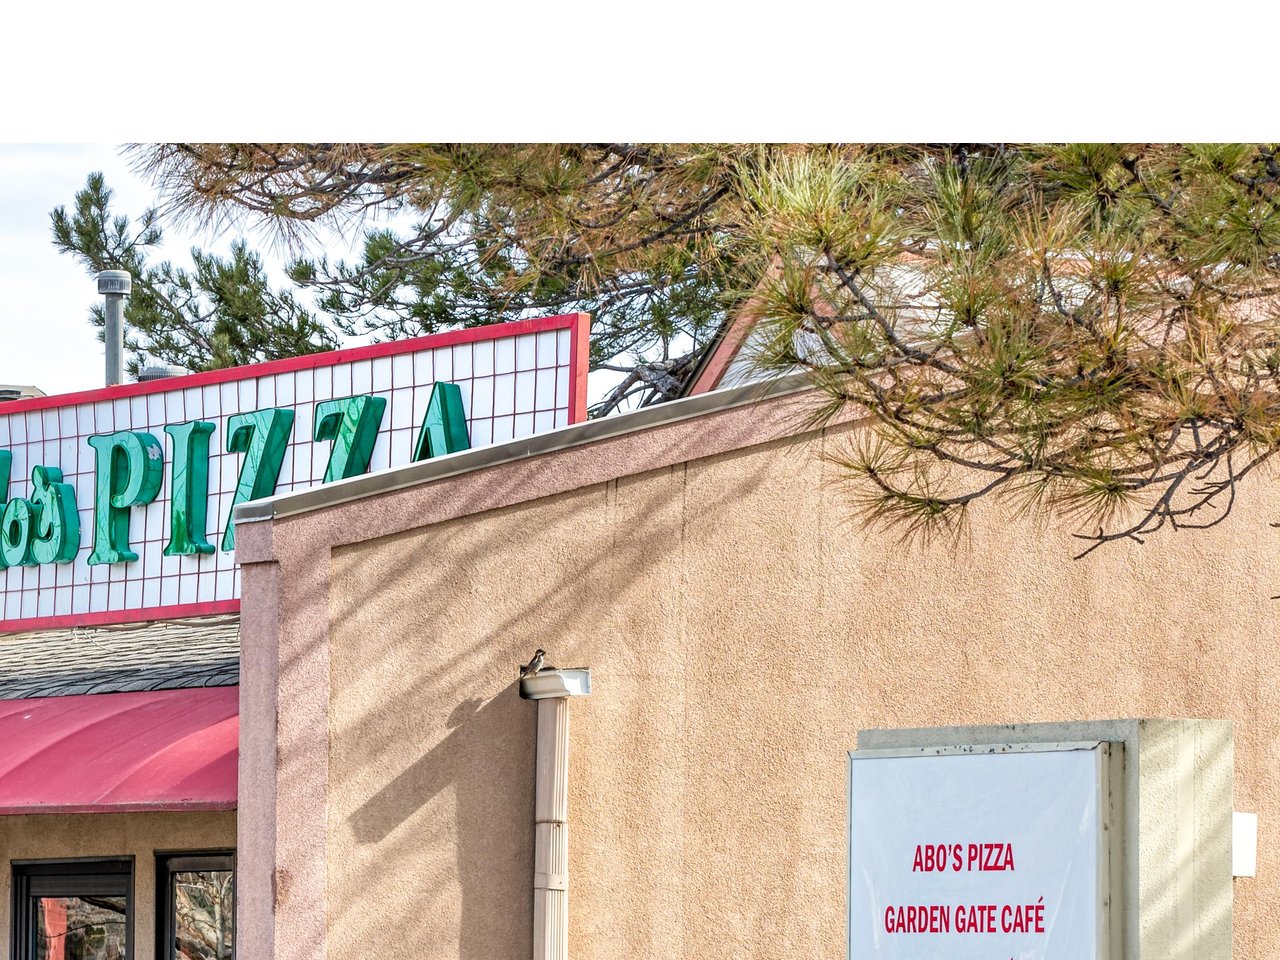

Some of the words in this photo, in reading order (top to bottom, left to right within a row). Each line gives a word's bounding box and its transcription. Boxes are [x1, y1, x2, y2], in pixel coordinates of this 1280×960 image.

[913, 843, 962, 872] ABO'S
[967, 843, 1015, 871] PIZZA
[884, 904, 951, 934] GARDEN
[955, 904, 998, 933] GATE
[1001, 896, 1045, 934] CAFÉ
